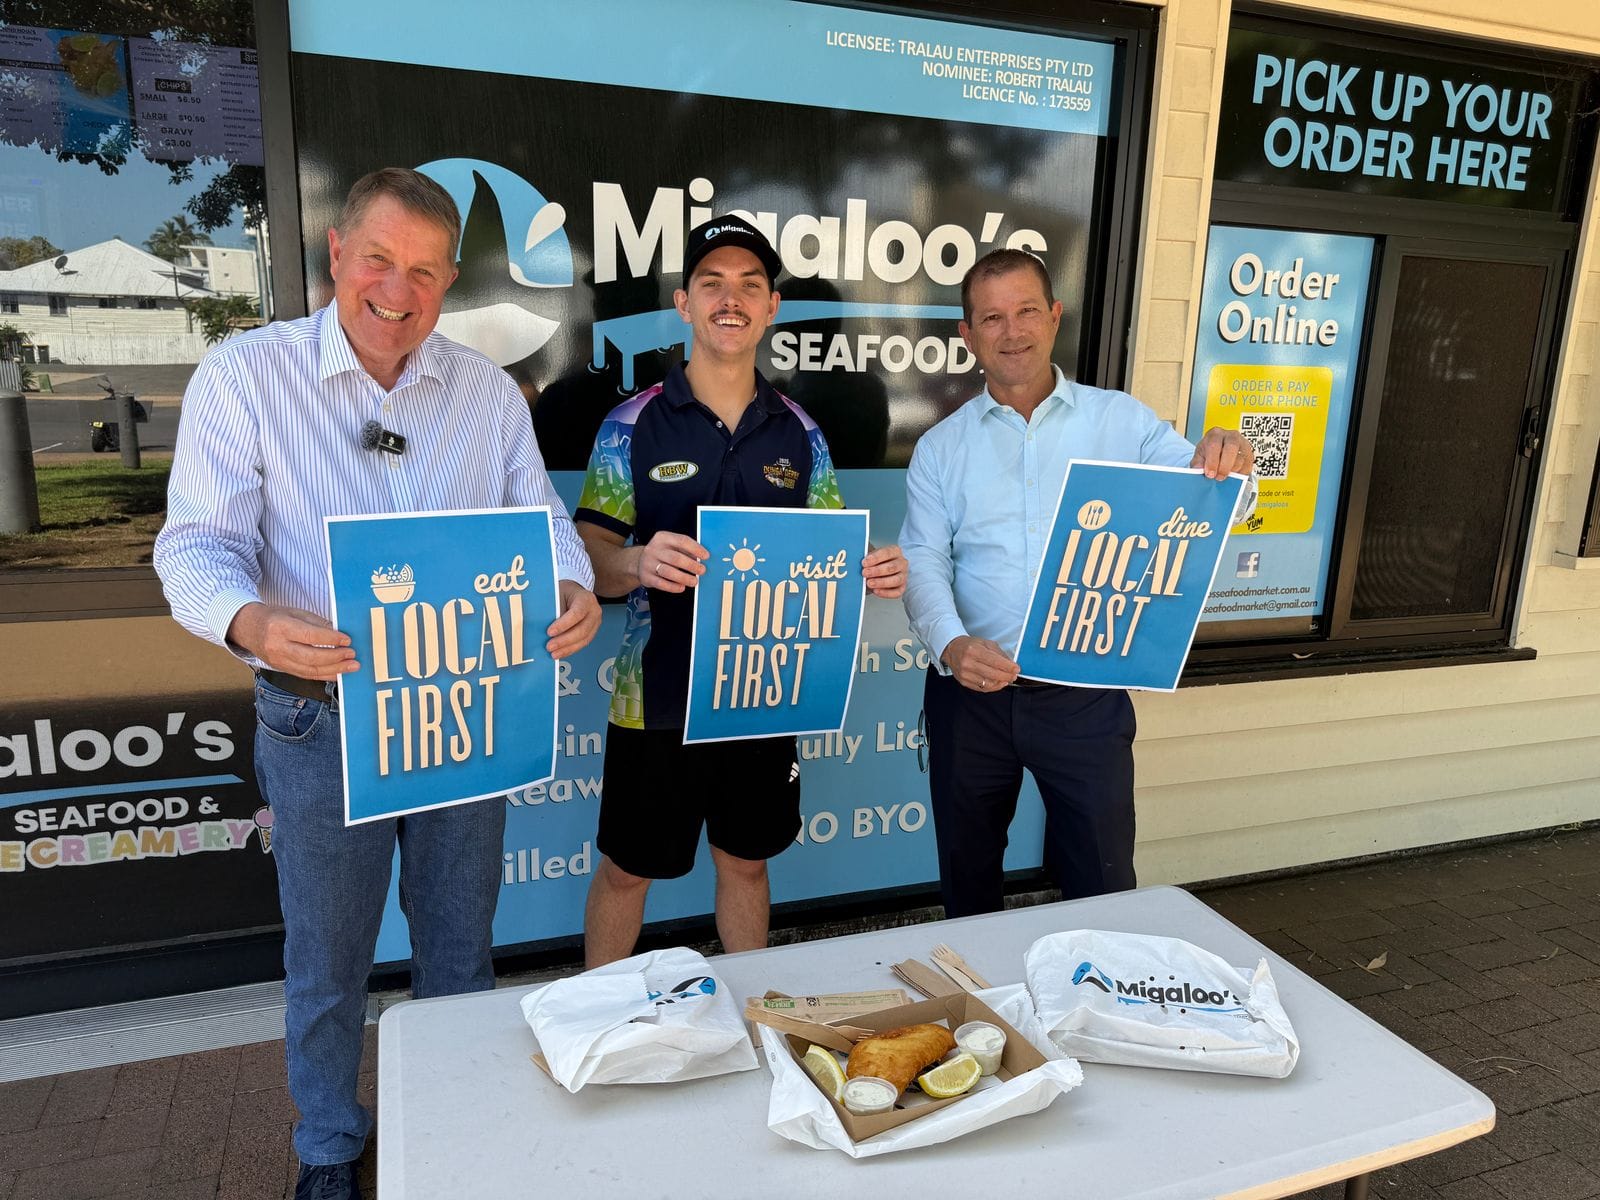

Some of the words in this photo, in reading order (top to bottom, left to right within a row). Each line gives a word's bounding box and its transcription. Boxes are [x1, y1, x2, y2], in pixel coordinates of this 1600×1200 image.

[826, 30, 895, 53] LICENSEE:
[898, 39, 953, 60] TRALAU
[957, 47, 1042, 70] ENTERPRISES
[1045, 60, 1068, 74] PTY
[1072, 63, 1093, 77] LTD
[159, 81, 187, 91] CHIPS
[922, 61, 992, 82] NOMINEE:
[995, 71, 1043, 89] ROBERT
[1046, 77, 1093, 94] TRALAU
[1252, 53, 1361, 116] PICK
[1371, 70, 1430, 122] UP
[1441, 79, 1553, 140] YOUR
[140, 93, 167, 102] SMALL
[141, 112, 168, 120] LARGE
[962, 84, 1015, 103] LICENCE
[1018, 90, 1039, 106] No.
[1049, 94, 1091, 112] 173559
[160, 127, 193, 136] GRAVY
[165, 139, 191, 147] $3.00
[1263, 116, 1414, 180] ORDER
[1426, 136, 1532, 191] HERE
[1230, 252, 1339, 300] Order
[1217, 300, 1339, 347] Online
[770, 331, 977, 375] SEAFOOD
[1219, 394, 1237, 406] ON
[1242, 394, 1273, 406] YOUR
[1277, 395, 1318, 407] PHONE
[1232, 379, 1272, 391] ORDER
[1276, 381, 1284, 392] &
[1288, 381, 1310, 392] PAY
[1282, 489, 1295, 497] visit
[1157, 506, 1213, 538] dine
[473, 554, 530, 594] eat
[789, 549, 848, 579] visit
[1056, 529, 1190, 597] LOCAL
[719, 579, 841, 640] LOCAL
[1039, 587, 1151, 657] FIRST
[370, 594, 535, 683] LOCAL
[713, 643, 811, 710] FIRST
[376, 676, 500, 776] FIRST
[796, 731, 863, 764] ully
[876, 721, 929, 752] Lic
[14, 797, 189, 834] SEAFOOD
[198, 796, 220, 815] &
[853, 801, 927, 838] BYO
